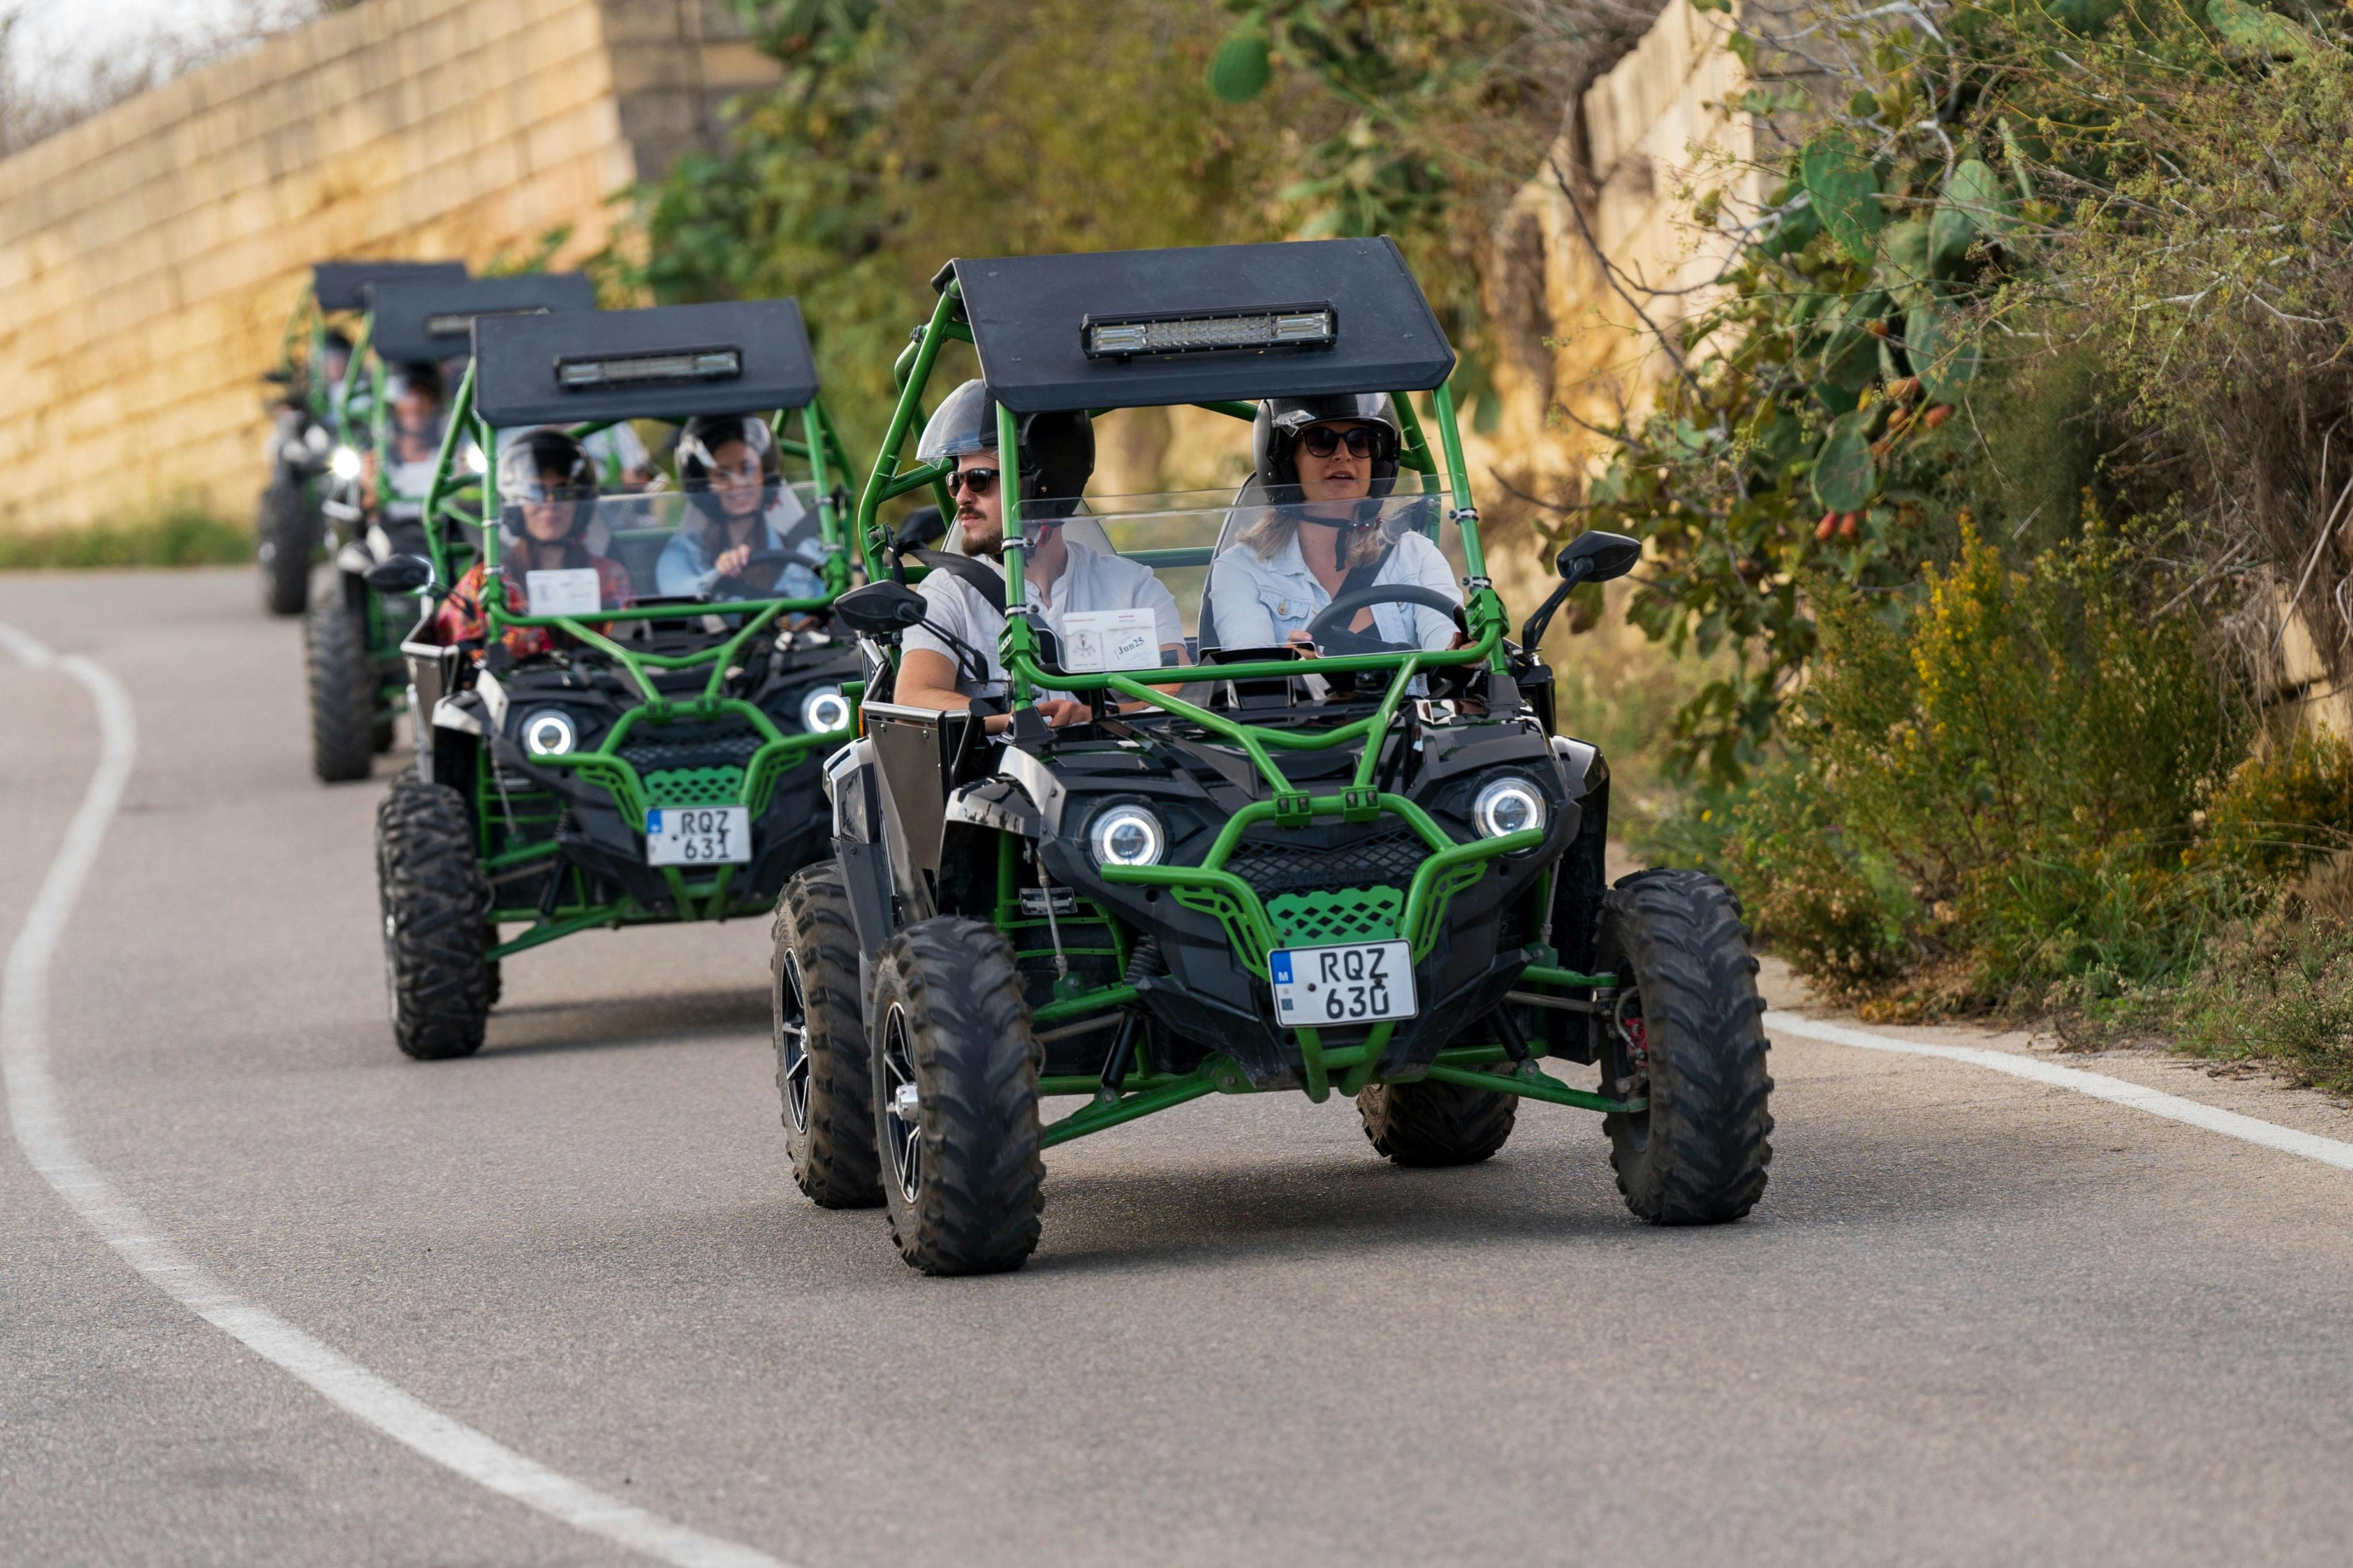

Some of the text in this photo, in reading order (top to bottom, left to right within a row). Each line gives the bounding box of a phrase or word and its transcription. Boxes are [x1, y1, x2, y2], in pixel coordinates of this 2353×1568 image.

[1118, 636, 1144, 655] Jun25
[681, 810, 731, 834] RQZ
[685, 836, 730, 859] 631
[1278, 971, 1289, 981] M
[1320, 948, 1388, 983] RQZ
[1326, 984, 1389, 1019] 630
